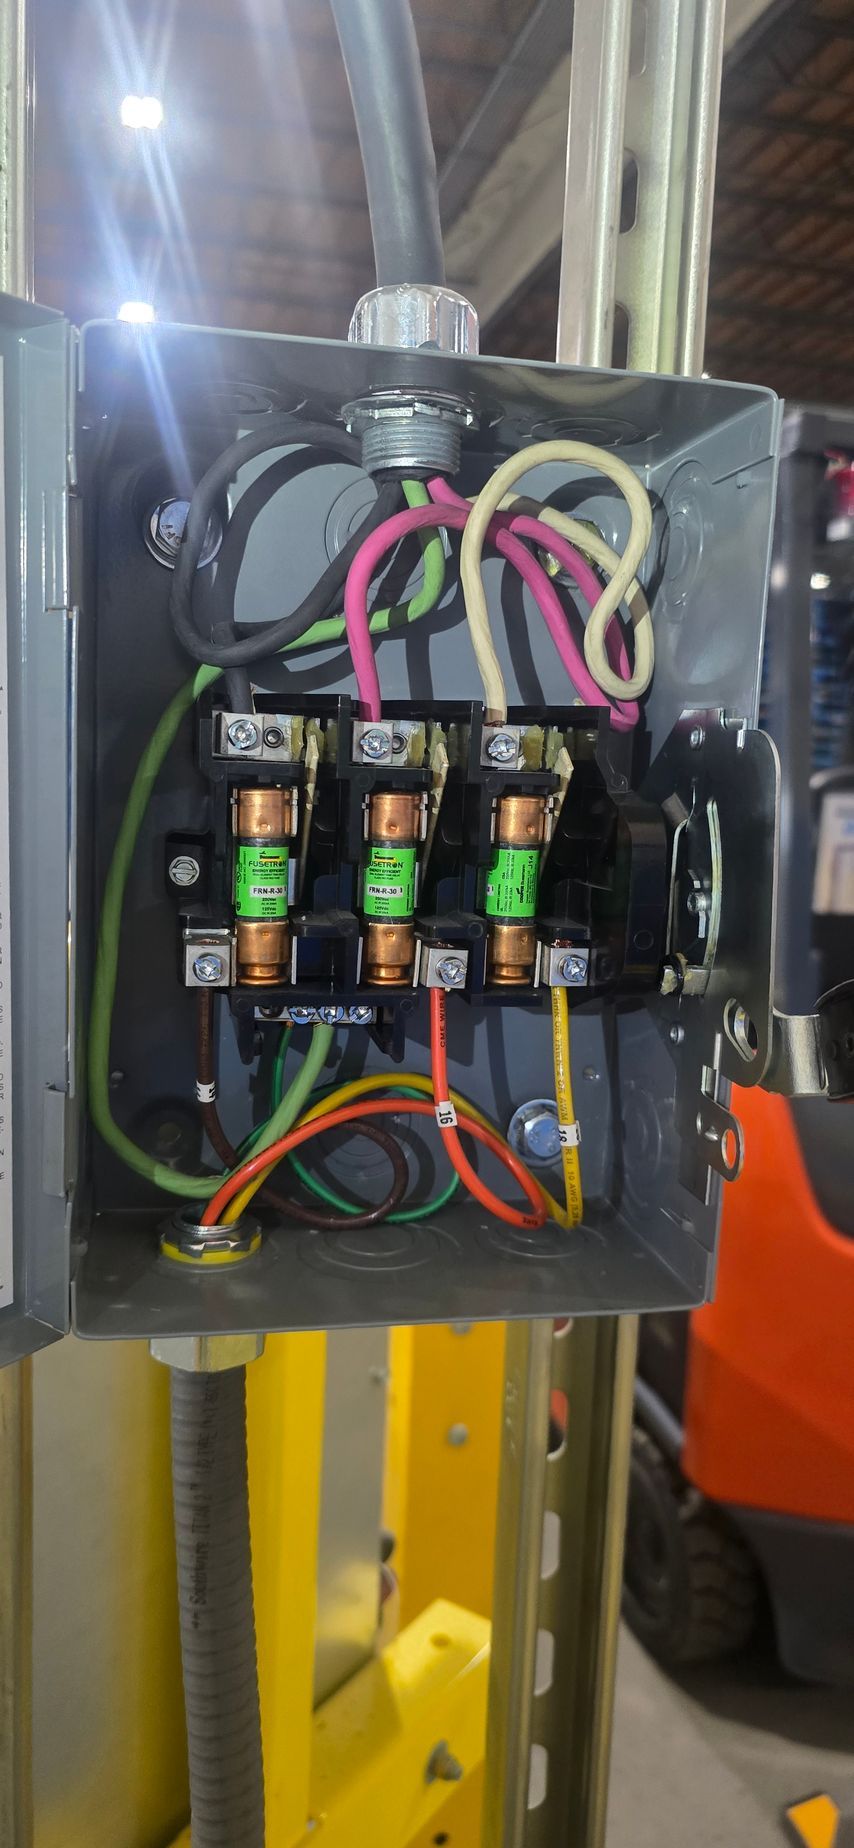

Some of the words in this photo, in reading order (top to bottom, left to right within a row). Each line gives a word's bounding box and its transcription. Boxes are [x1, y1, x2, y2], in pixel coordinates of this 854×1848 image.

[248, 860, 287, 868] FUSETRON
[253, 887, 283, 895] FRN-R-30
[369, 886, 397, 895] FRN-R-30
[439, 1110, 453, 1124] 16
[569, 1183, 577, 1202] AWG
[189, 1541, 209, 1605] Southwire
